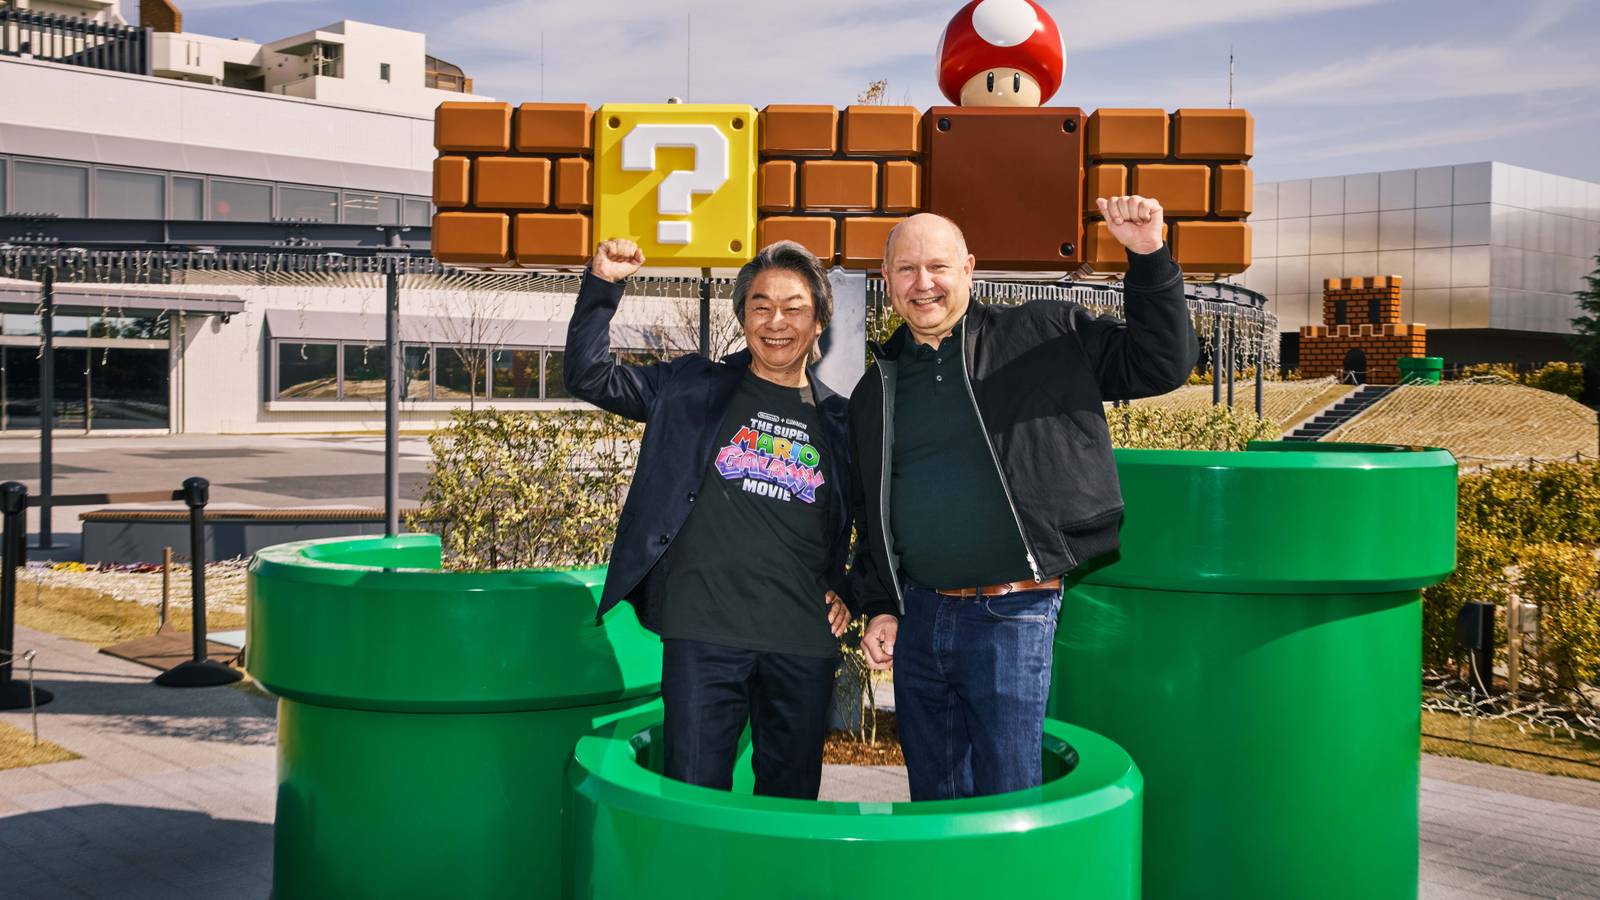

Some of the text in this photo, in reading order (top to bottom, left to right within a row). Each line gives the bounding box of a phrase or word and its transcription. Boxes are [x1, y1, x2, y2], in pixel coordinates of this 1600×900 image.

[622, 124, 729, 244] ?
[731, 426, 820, 468] MARIO
[750, 418, 773, 433] THE
[773, 425, 810, 443] SUPER
[715, 445, 825, 503] GALAXY
[742, 478, 791, 502] MOVIE
